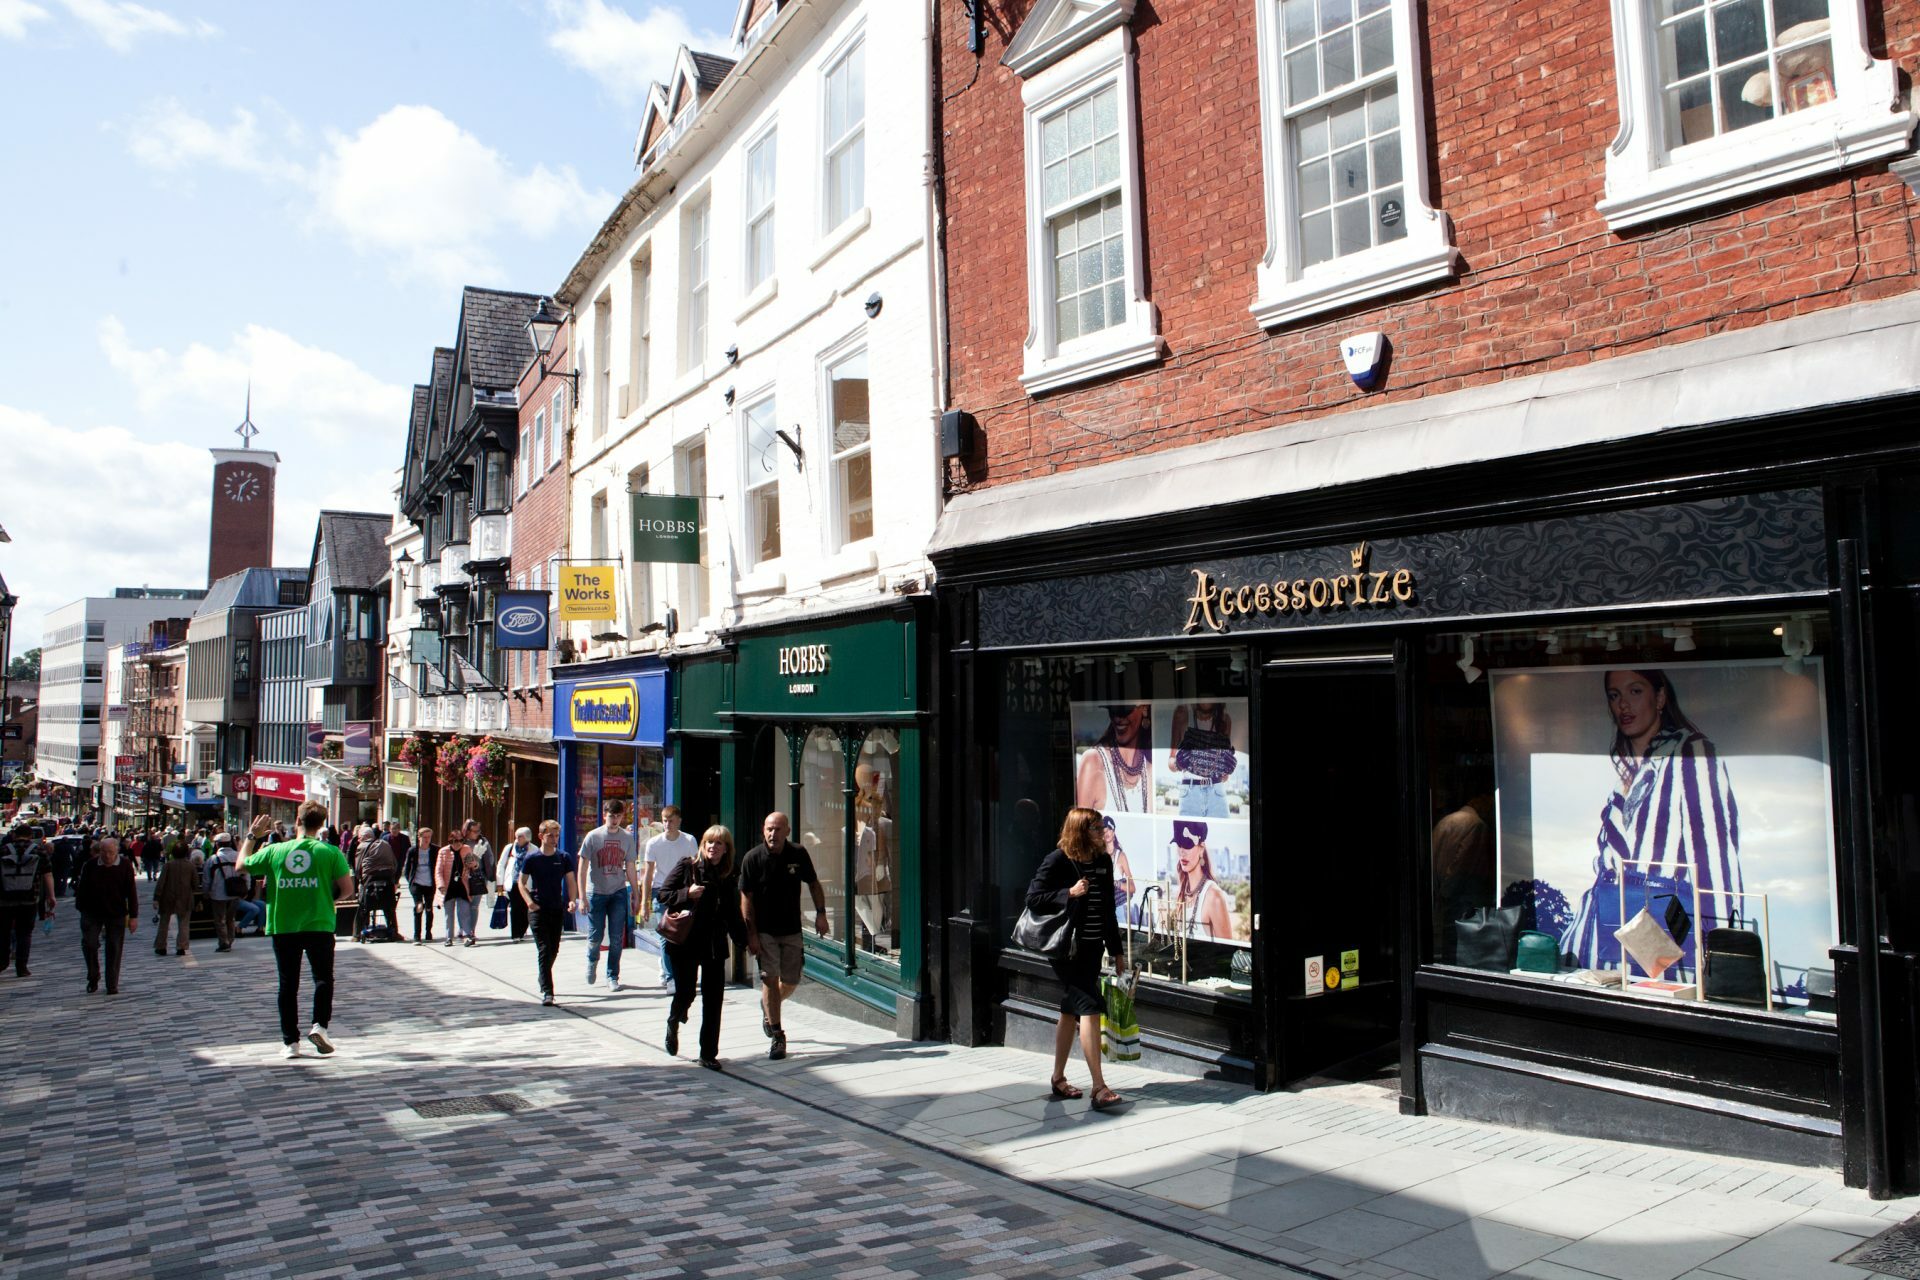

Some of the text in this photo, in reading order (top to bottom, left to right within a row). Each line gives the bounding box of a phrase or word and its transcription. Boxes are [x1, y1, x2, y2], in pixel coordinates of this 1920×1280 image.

[639, 519, 695, 533] HOBBS
[574, 574, 600, 586] The
[1183, 541, 1412, 631] Accessorize
[564, 588, 610, 600] Works
[505, 612, 537, 628] Boots
[779, 644, 826, 675] HOBBS
[789, 683, 814, 694] LONDON
[278, 877, 318, 888] OXFAM
